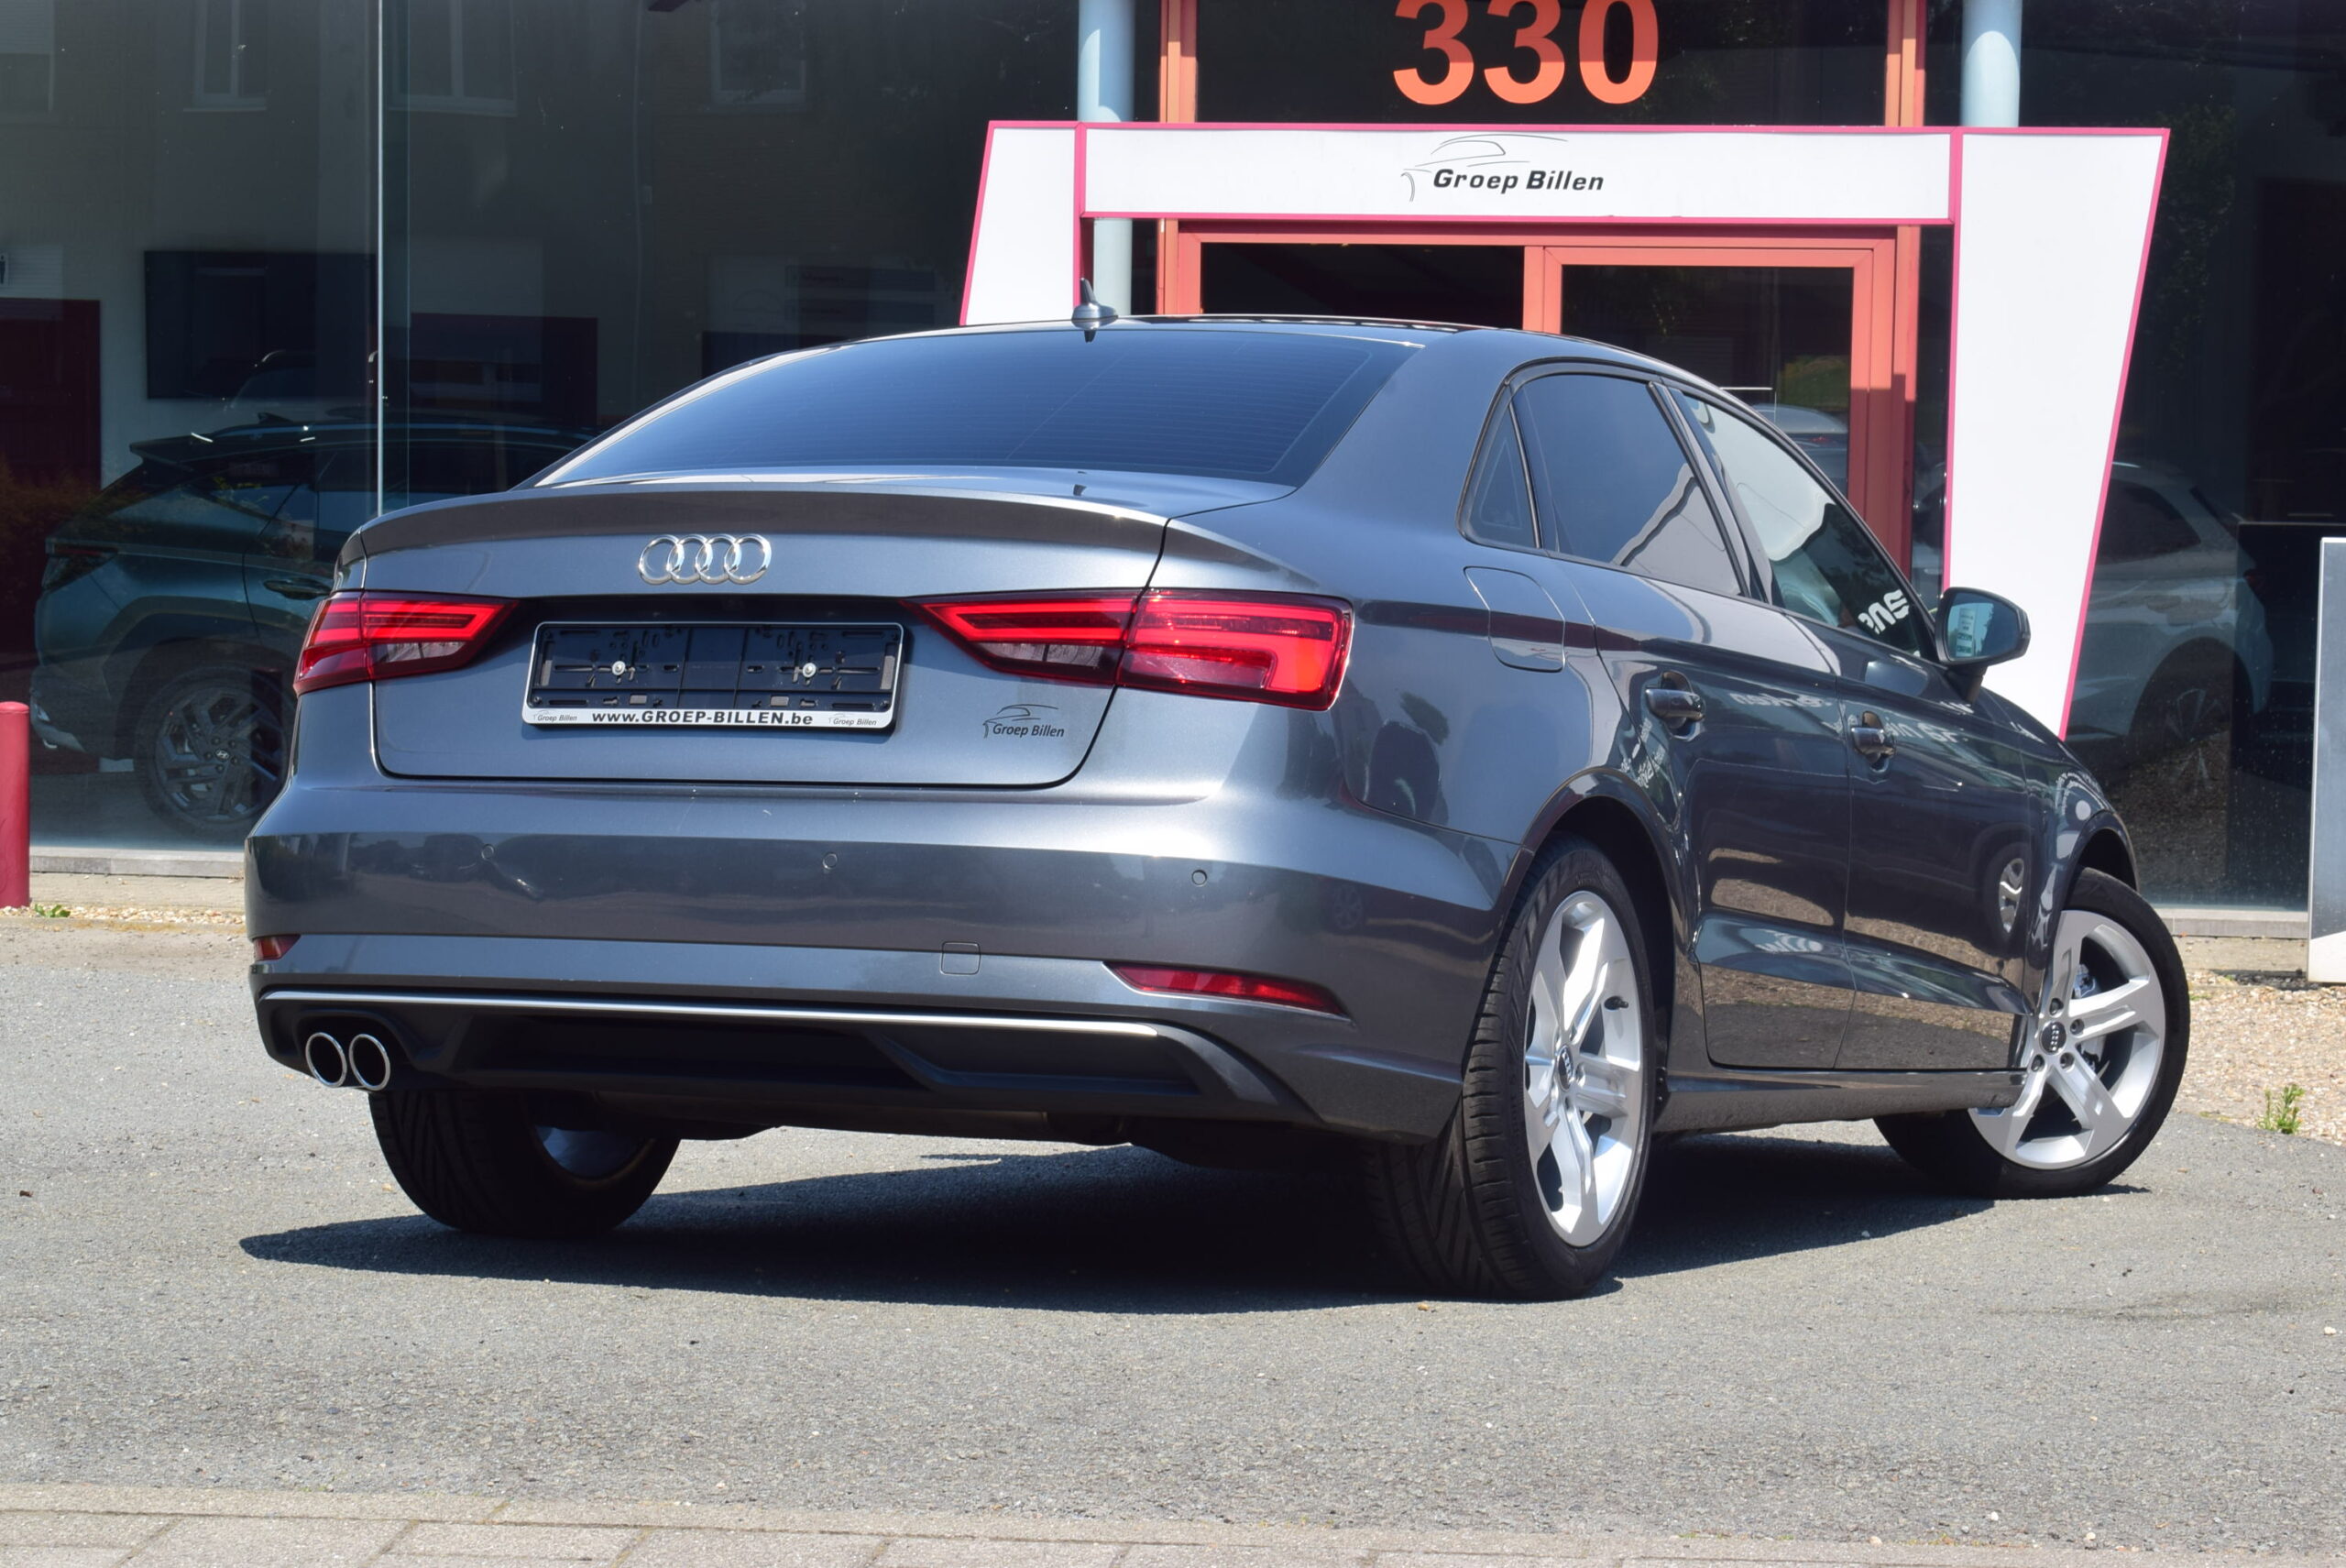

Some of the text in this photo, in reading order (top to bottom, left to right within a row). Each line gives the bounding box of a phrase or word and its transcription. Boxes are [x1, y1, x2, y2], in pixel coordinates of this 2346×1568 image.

[1393, 0, 1659, 104] 330
[1433, 169, 1604, 194] Groep Billen
[537, 714, 557, 722] Groep
[592, 710, 813, 725] www.GROEP-BILLEN.be
[833, 718, 855, 726] Groep
[992, 723, 1065, 738] Groep Billen
